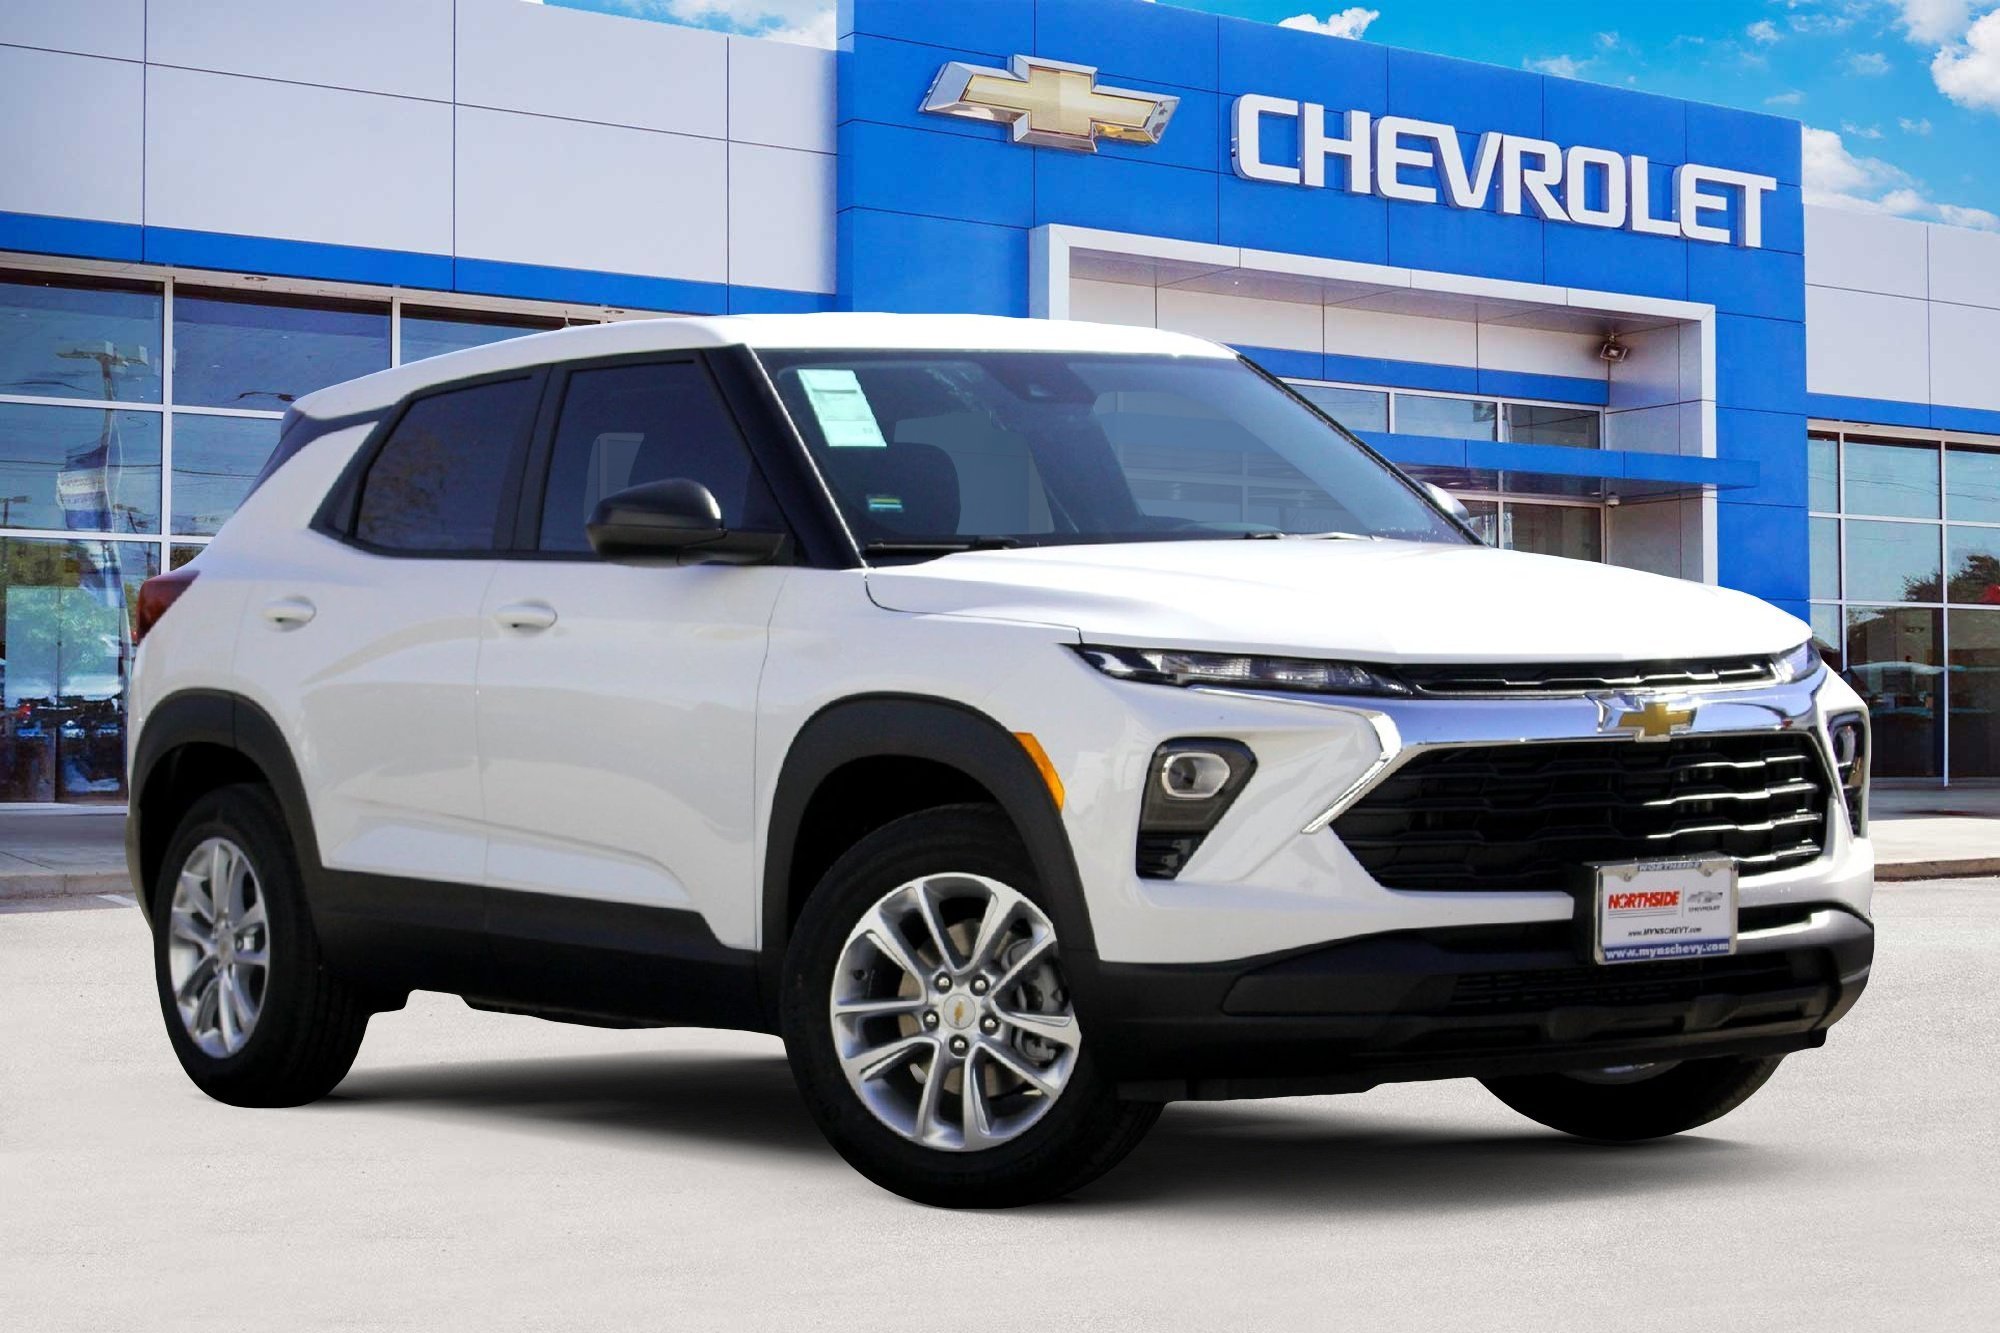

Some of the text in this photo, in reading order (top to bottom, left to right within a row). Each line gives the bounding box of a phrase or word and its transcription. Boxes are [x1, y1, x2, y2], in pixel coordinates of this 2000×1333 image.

[1232, 93, 1777, 247] CHEVROLET
[1608, 891, 1680, 909] NORTHSIDE
[1605, 942, 1729, 959] www.mynschevy.com
